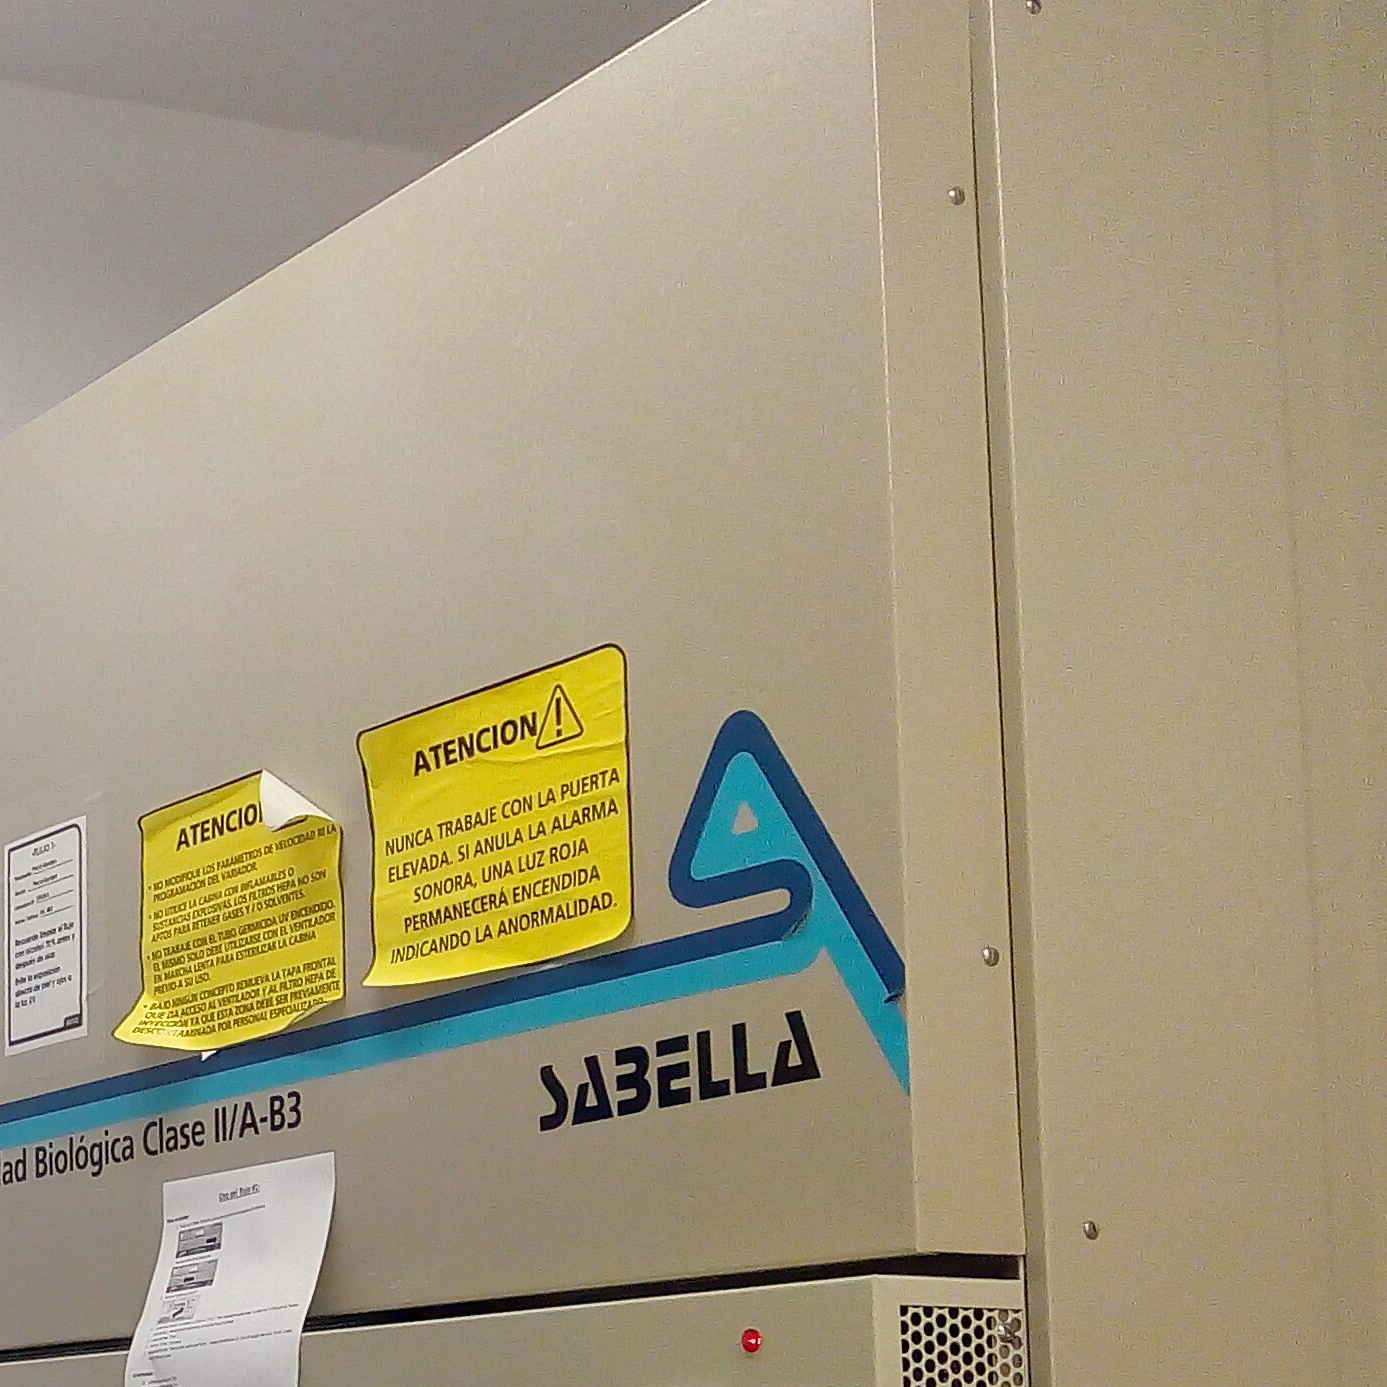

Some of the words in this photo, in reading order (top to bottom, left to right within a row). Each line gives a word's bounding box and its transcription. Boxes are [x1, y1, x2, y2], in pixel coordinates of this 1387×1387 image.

[414, 711, 538, 777] ATENCION
[176, 801, 263, 852] ATENCIO
[386, 828, 433, 857] NUNCA
[437, 805, 497, 838] TRABAJE
[501, 798, 533, 820] CON
[538, 791, 557, 814] LA
[561, 768, 620, 807] PUERTA
[388, 854, 454, 883] ELEVADA.
[458, 844, 470, 862] SI
[473, 828, 525, 858] ANULA
[528, 819, 547, 841] LA
[551, 797, 619, 834] ALARMA
[154, 881, 163, 891] NO
[154, 909, 163, 920] NO
[287, 867, 294, 877] O
[404, 887, 509, 934] PERMANECERÁ
[513, 865, 601, 902] ENCENDIDA
[413, 874, 477, 904] SONORA,
[482, 860, 514, 884] UNA
[518, 849, 546, 872] LUZ
[549, 837, 589, 864] ROJA
[390, 929, 471, 965] INDICANDO
[475, 924, 494, 944] LA
[497, 891, 618, 939] ANORMALIDAD.
[539, 1010, 822, 1132] SABELLA
[35, 1128, 134, 1179] Biológica
[143, 1114, 205, 1157] Clase
[214, 1089, 303, 1145] II/A-B3
